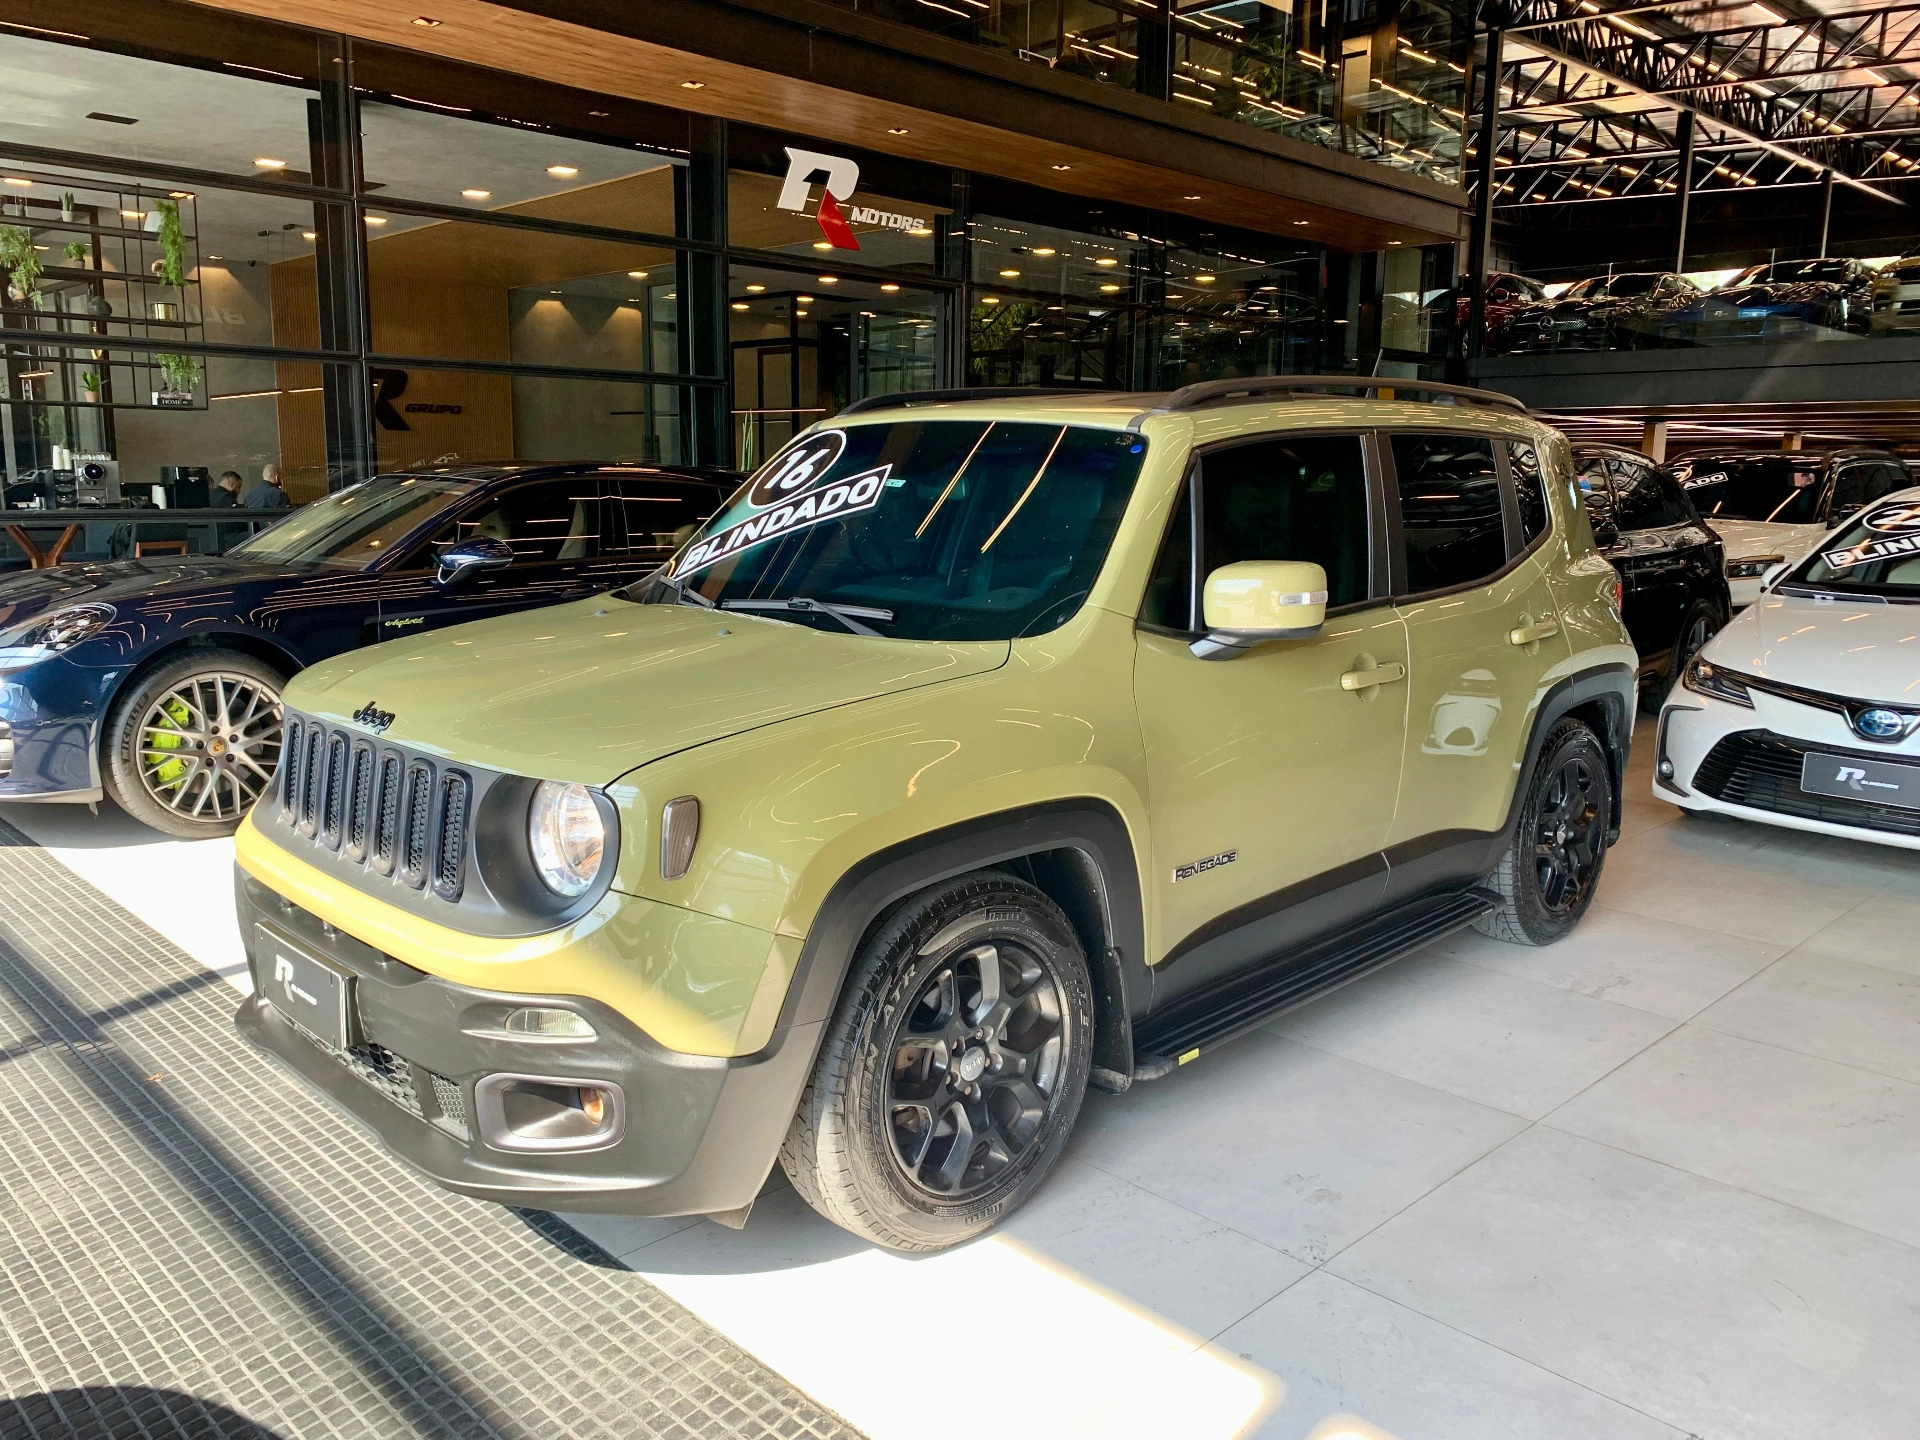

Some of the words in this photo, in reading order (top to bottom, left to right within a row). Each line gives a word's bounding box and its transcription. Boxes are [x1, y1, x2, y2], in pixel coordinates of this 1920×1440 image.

[777, 146, 861, 251] R
[851, 206, 925, 231] MOTORS
[405, 403, 463, 415] GRUPO
[764, 448, 831, 490] 16
[682, 475, 881, 572] BLINDADO
[121, 693, 148, 761] MICHELIN
[353, 700, 396, 735] Jeep
[1836, 766, 1865, 791] R
[1171, 850, 1237, 883] RENEGADE
[985, 907, 1021, 921] PIRELLI
[275, 954, 295, 1003] R
[861, 1042, 899, 1207] SCORPION
[883, 963, 917, 1029] ATR
[964, 1202, 1003, 1225] PIRELLI
